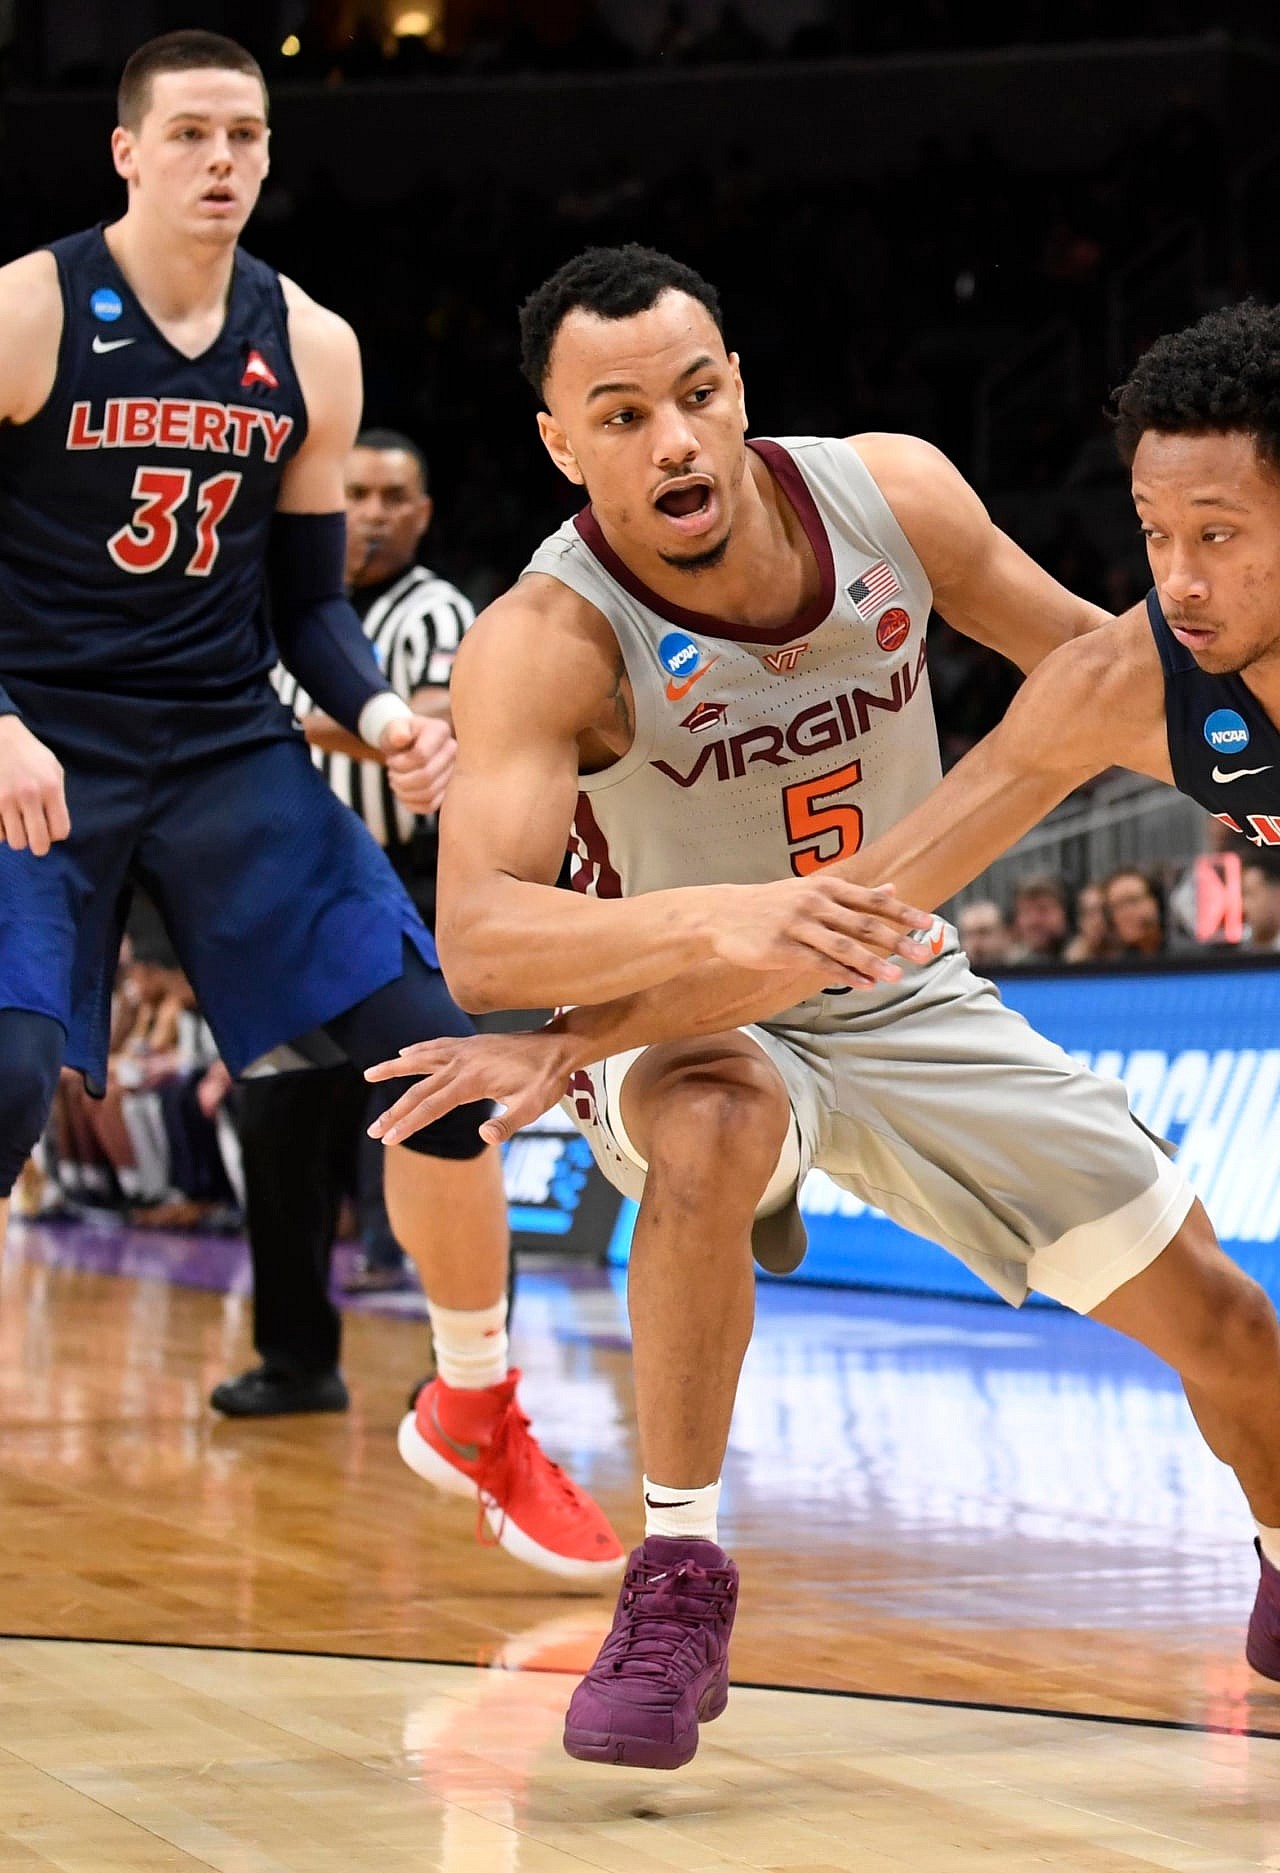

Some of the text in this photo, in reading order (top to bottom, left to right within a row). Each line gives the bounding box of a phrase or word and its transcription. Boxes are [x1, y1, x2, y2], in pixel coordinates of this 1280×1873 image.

[66, 397, 293, 462] LIBERTY
[107, 466, 242, 576] 31
[667, 644, 699, 671] NCAA
[763, 642, 808, 672] VT
[650, 636, 928, 788] VIRGINIA
[1211, 730, 1248, 744] NCAA
[781, 758, 864, 878] 5
